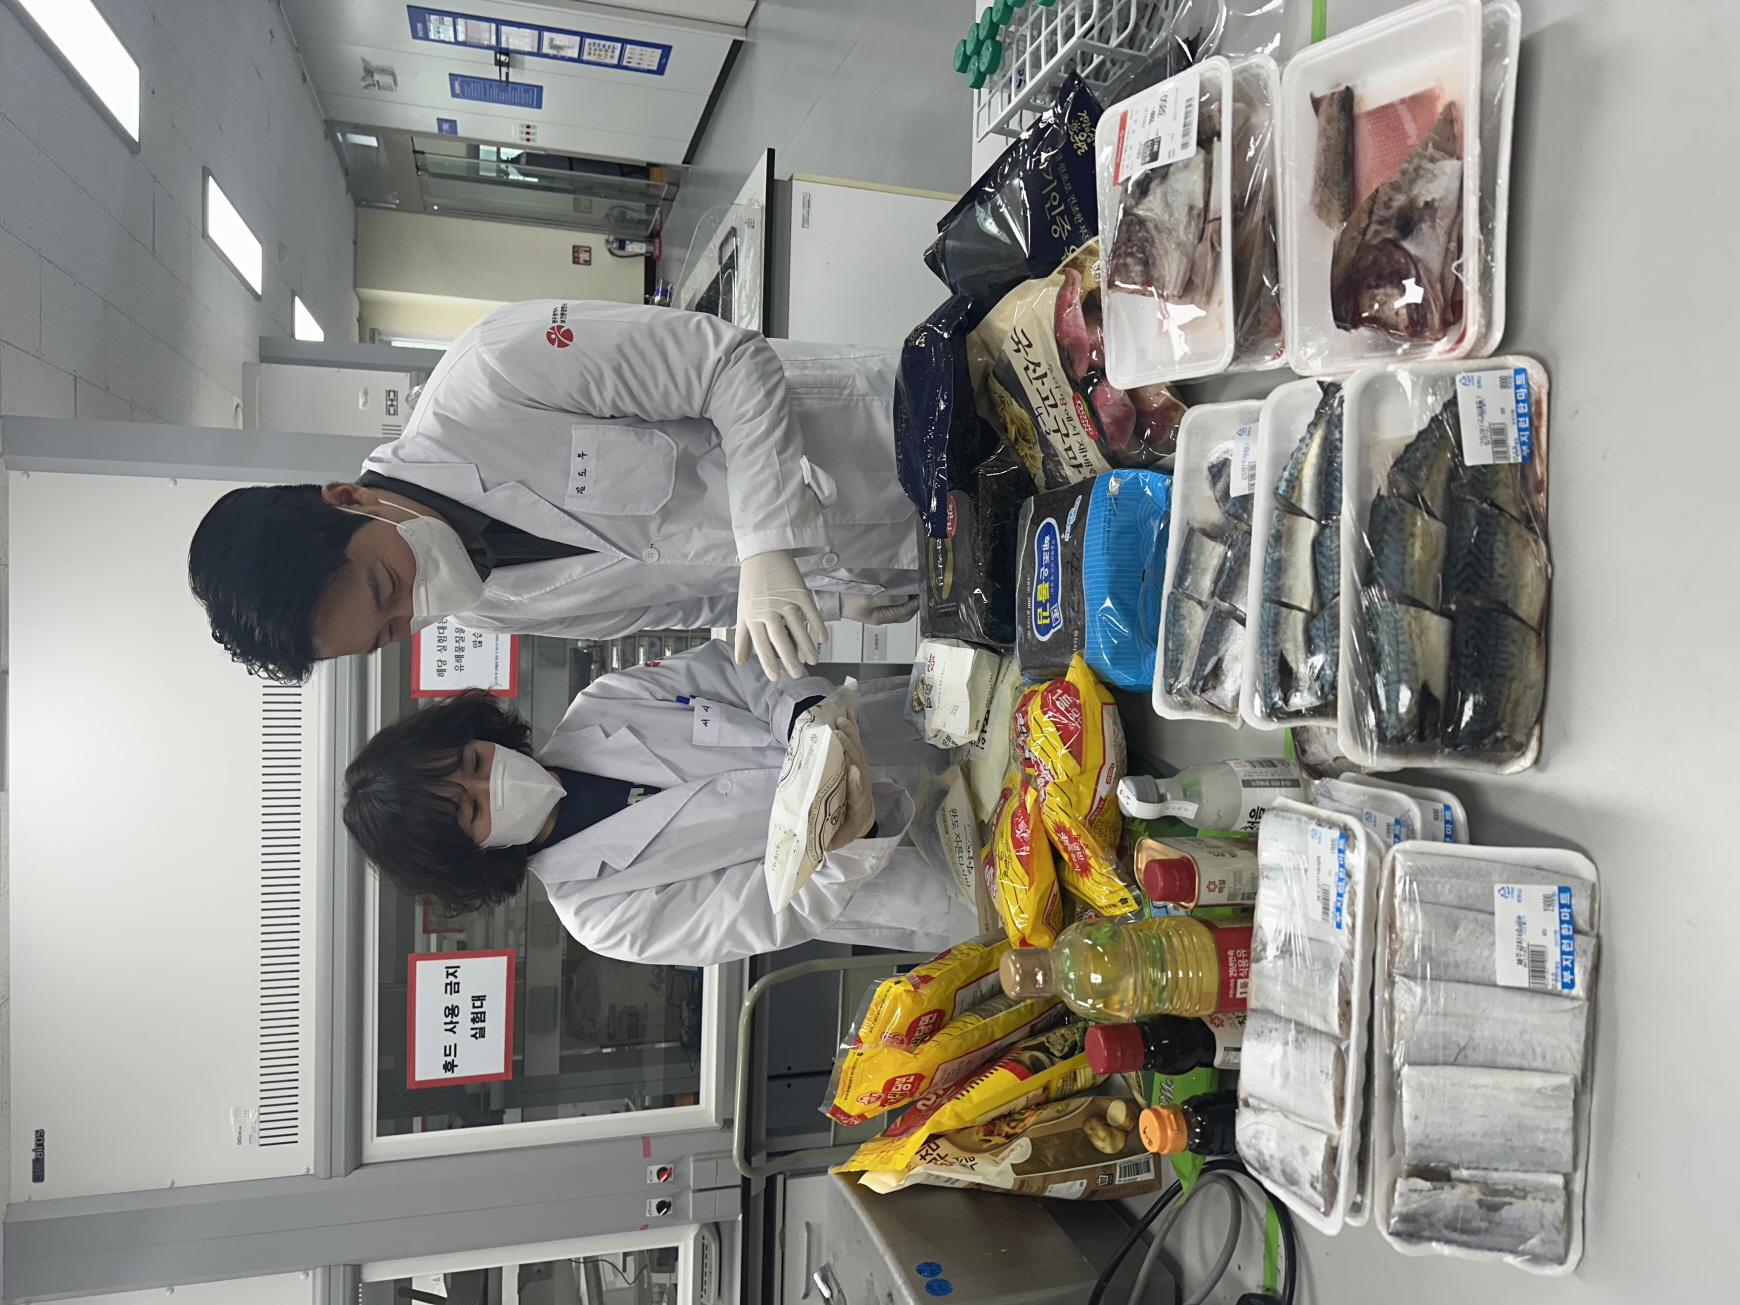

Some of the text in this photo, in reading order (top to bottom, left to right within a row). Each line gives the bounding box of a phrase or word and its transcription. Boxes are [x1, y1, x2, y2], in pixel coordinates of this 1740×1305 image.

[1077, 224, 1091, 244] 부드
[1011, 326, 1081, 473] 국산고구마
[1057, 393, 1080, 438] 땅에서
[1074, 404, 1090, 433] WON
[1075, 399, 1095, 436] DONG
[1516, 373, 1530, 457] 부지런한마트
[576, 450, 588, 494] 김 도 우
[436, 658, 448, 678] 해당
[1560, 892, 1574, 984] 부지런한마트
[1236, 948, 1250, 977] 식용유
[443, 965, 460, 1074] 후드 사용 금지
[470, 994, 486, 1041] 실험대
